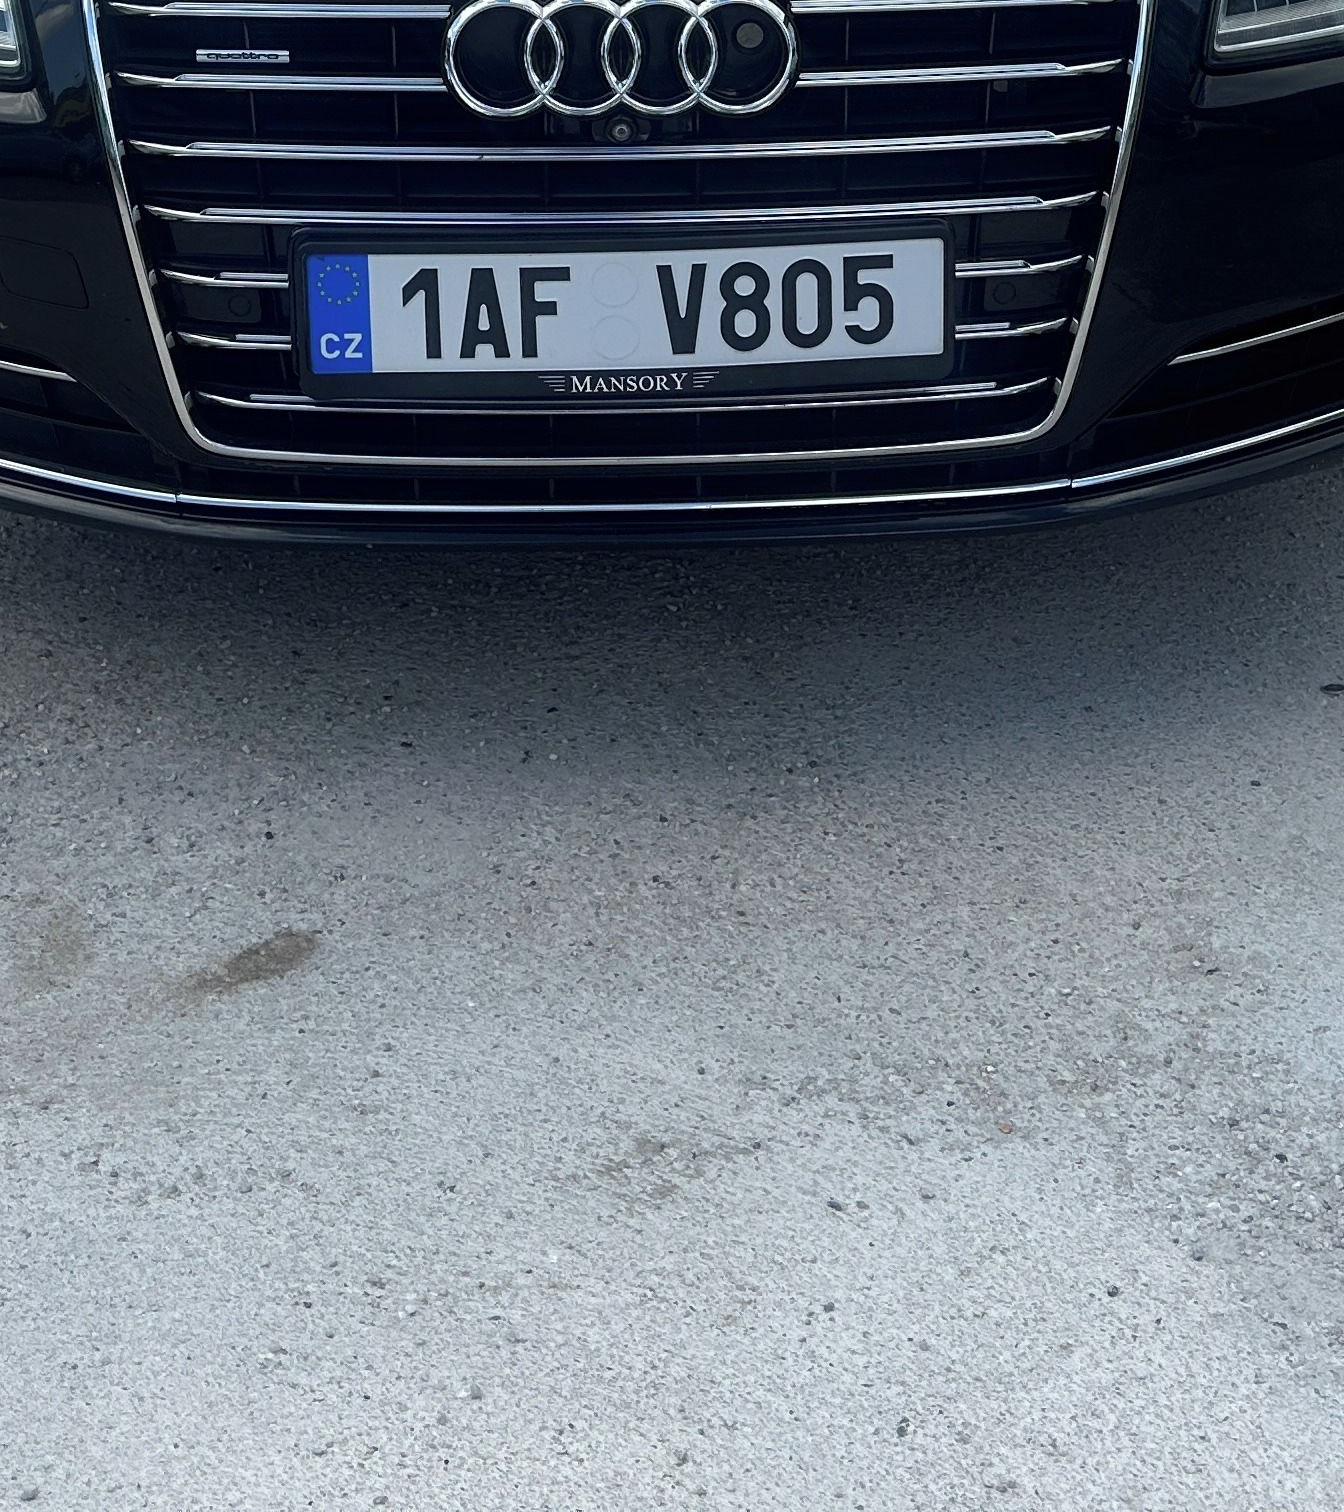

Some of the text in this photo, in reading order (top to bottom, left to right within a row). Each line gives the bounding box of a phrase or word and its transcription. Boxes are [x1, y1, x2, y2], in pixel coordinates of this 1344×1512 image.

[206, 51, 280, 60] quattro
[319, 253, 896, 361] CZ 1AF V805
[570, 371, 689, 394] MANSORY
